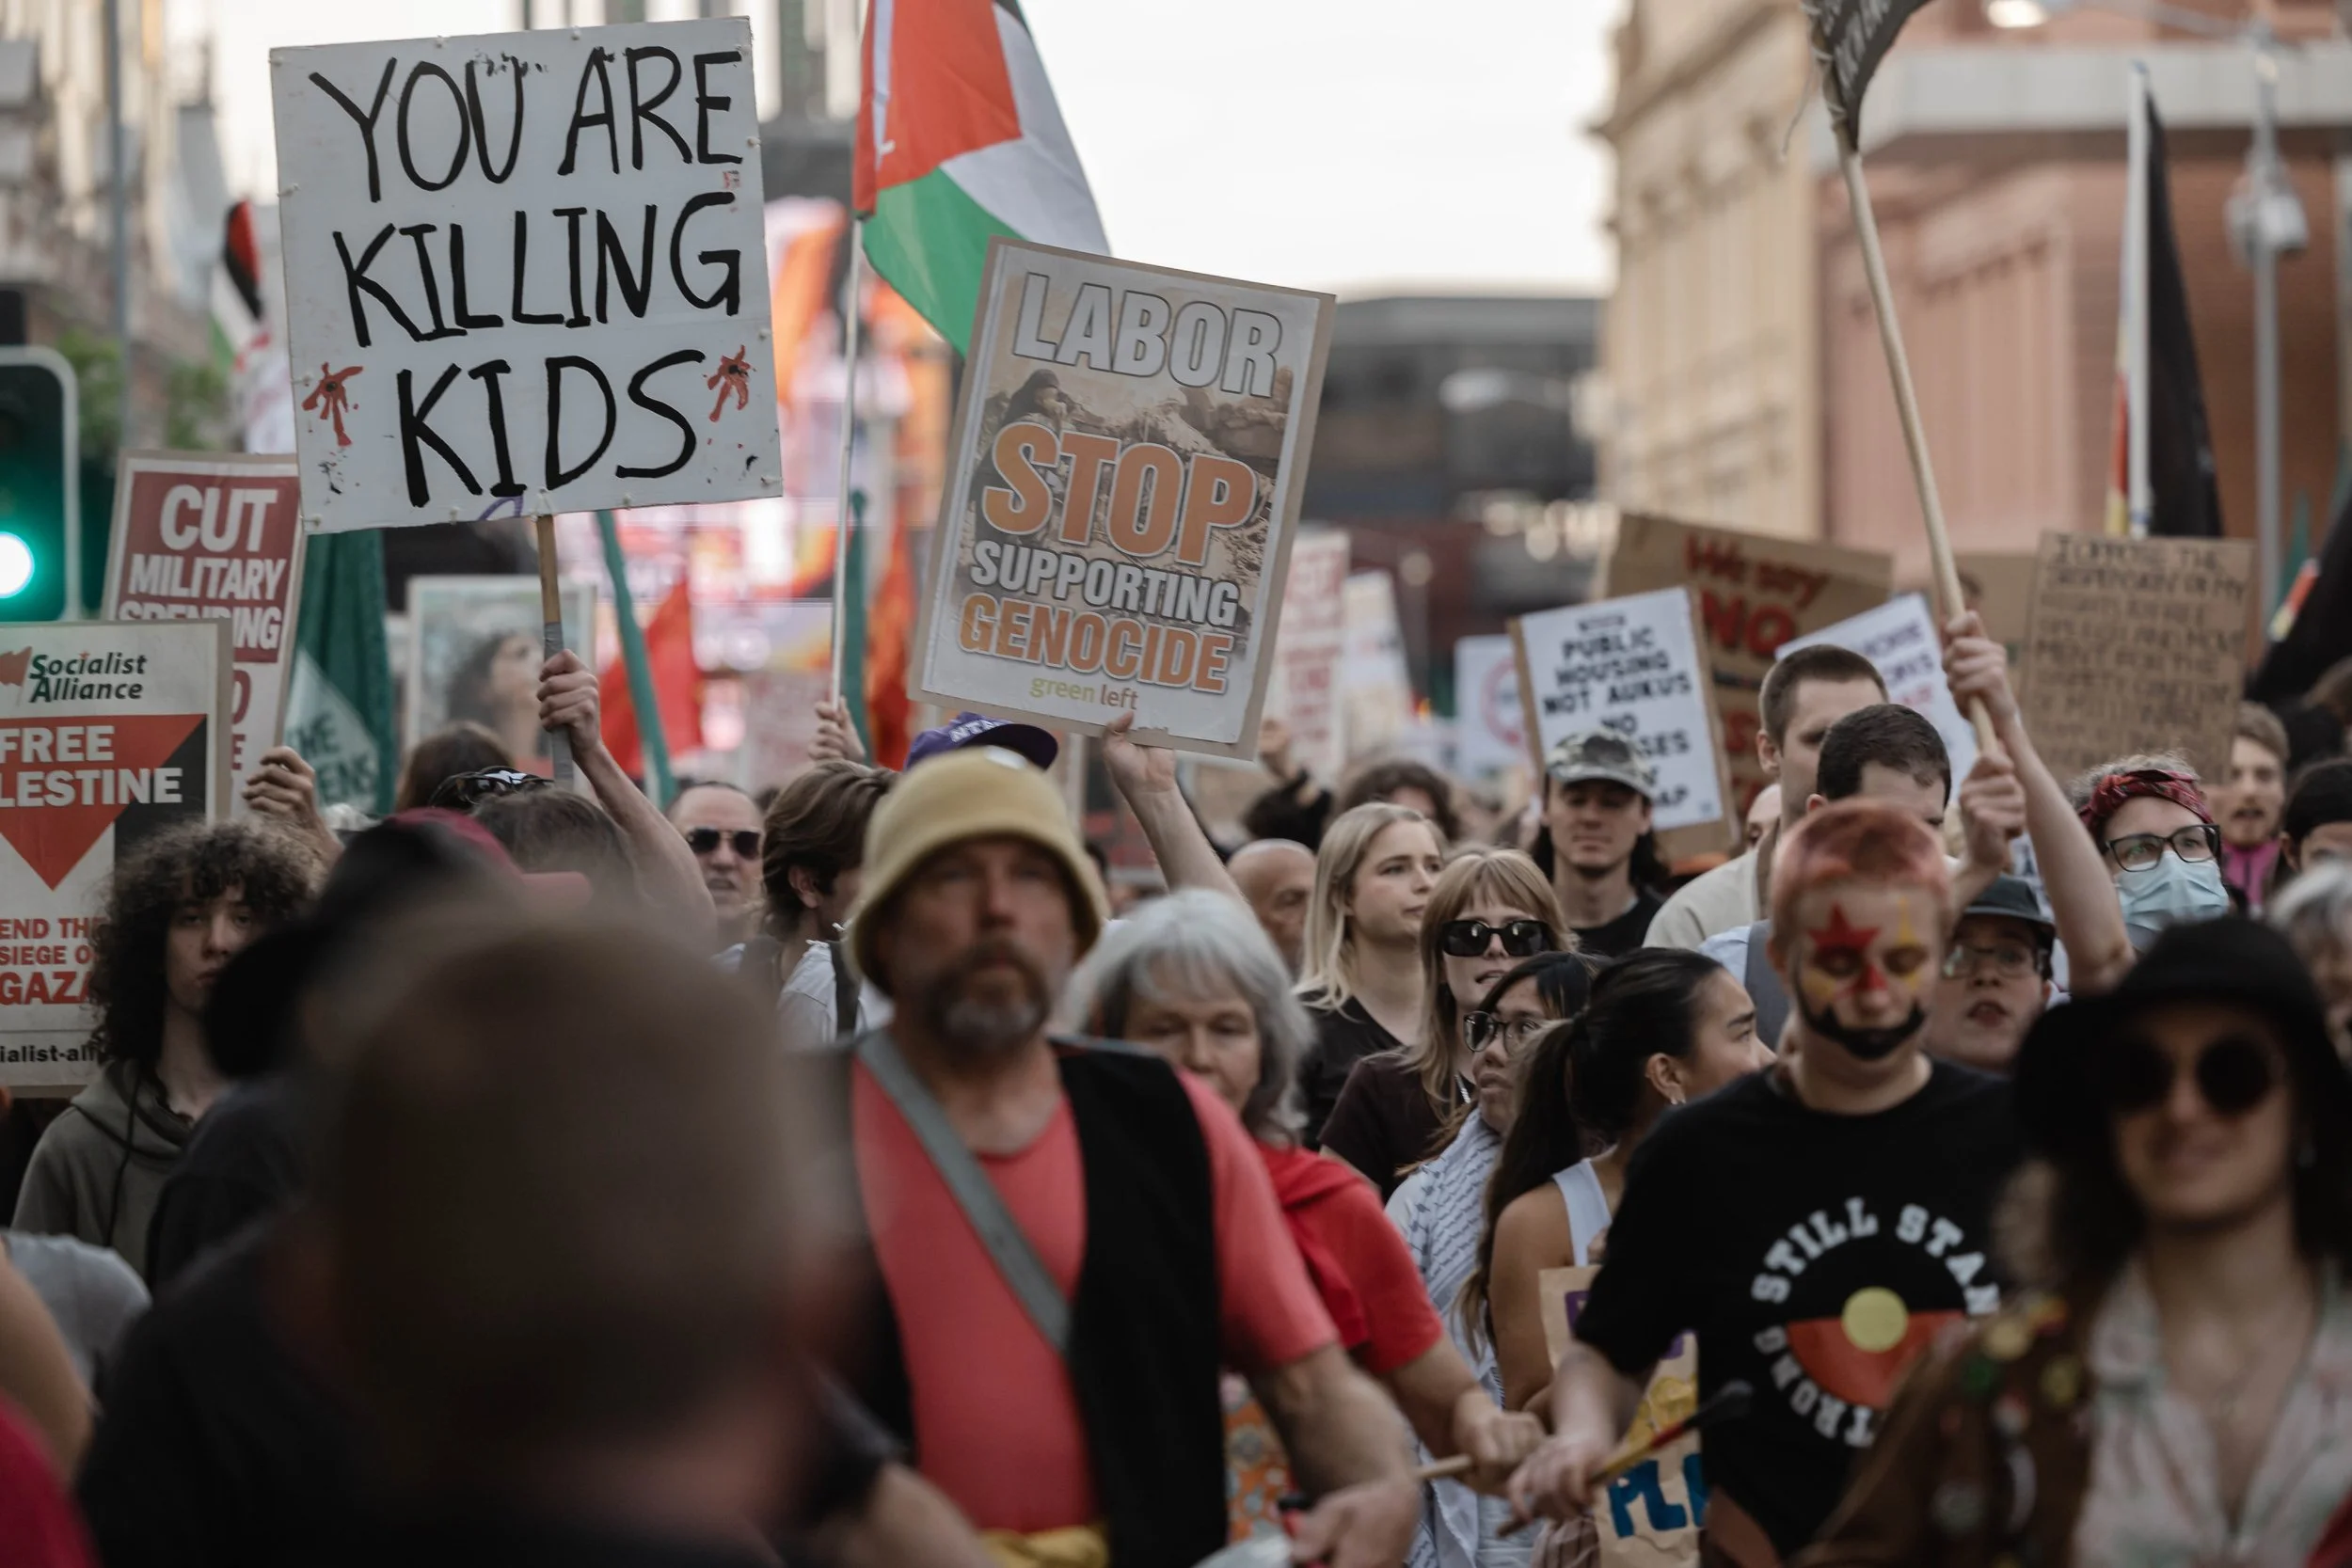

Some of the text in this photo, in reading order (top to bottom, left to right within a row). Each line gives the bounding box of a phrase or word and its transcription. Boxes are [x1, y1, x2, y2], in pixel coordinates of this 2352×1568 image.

[309, 46, 743, 202] YOU ARE
[333, 192, 741, 347] KILLING
[1012, 271, 1283, 399] LABOR
[396, 349, 706, 508] KIDS
[159, 483, 278, 553] CUT
[981, 421, 1259, 566] STOP
[128, 553, 287, 601] MILITARY
[970, 539, 1241, 628] SUPPORTING
[29, 651, 148, 679] Socialist
[957, 593, 1235, 695] GENOCIDE
[1555, 650, 1669, 686] HOUSING
[1563, 626, 1653, 659] PUBLIC
[28, 675, 144, 704] Alliance
[1028, 677, 1139, 710] green left
[1543, 685, 1591, 715] NOT
[0, 725, 115, 764] FREE
[0, 944, 67, 966] SIEGE
[1750, 1196, 1880, 1304] STILL
[1753, 1325, 1876, 1449] TRONG
